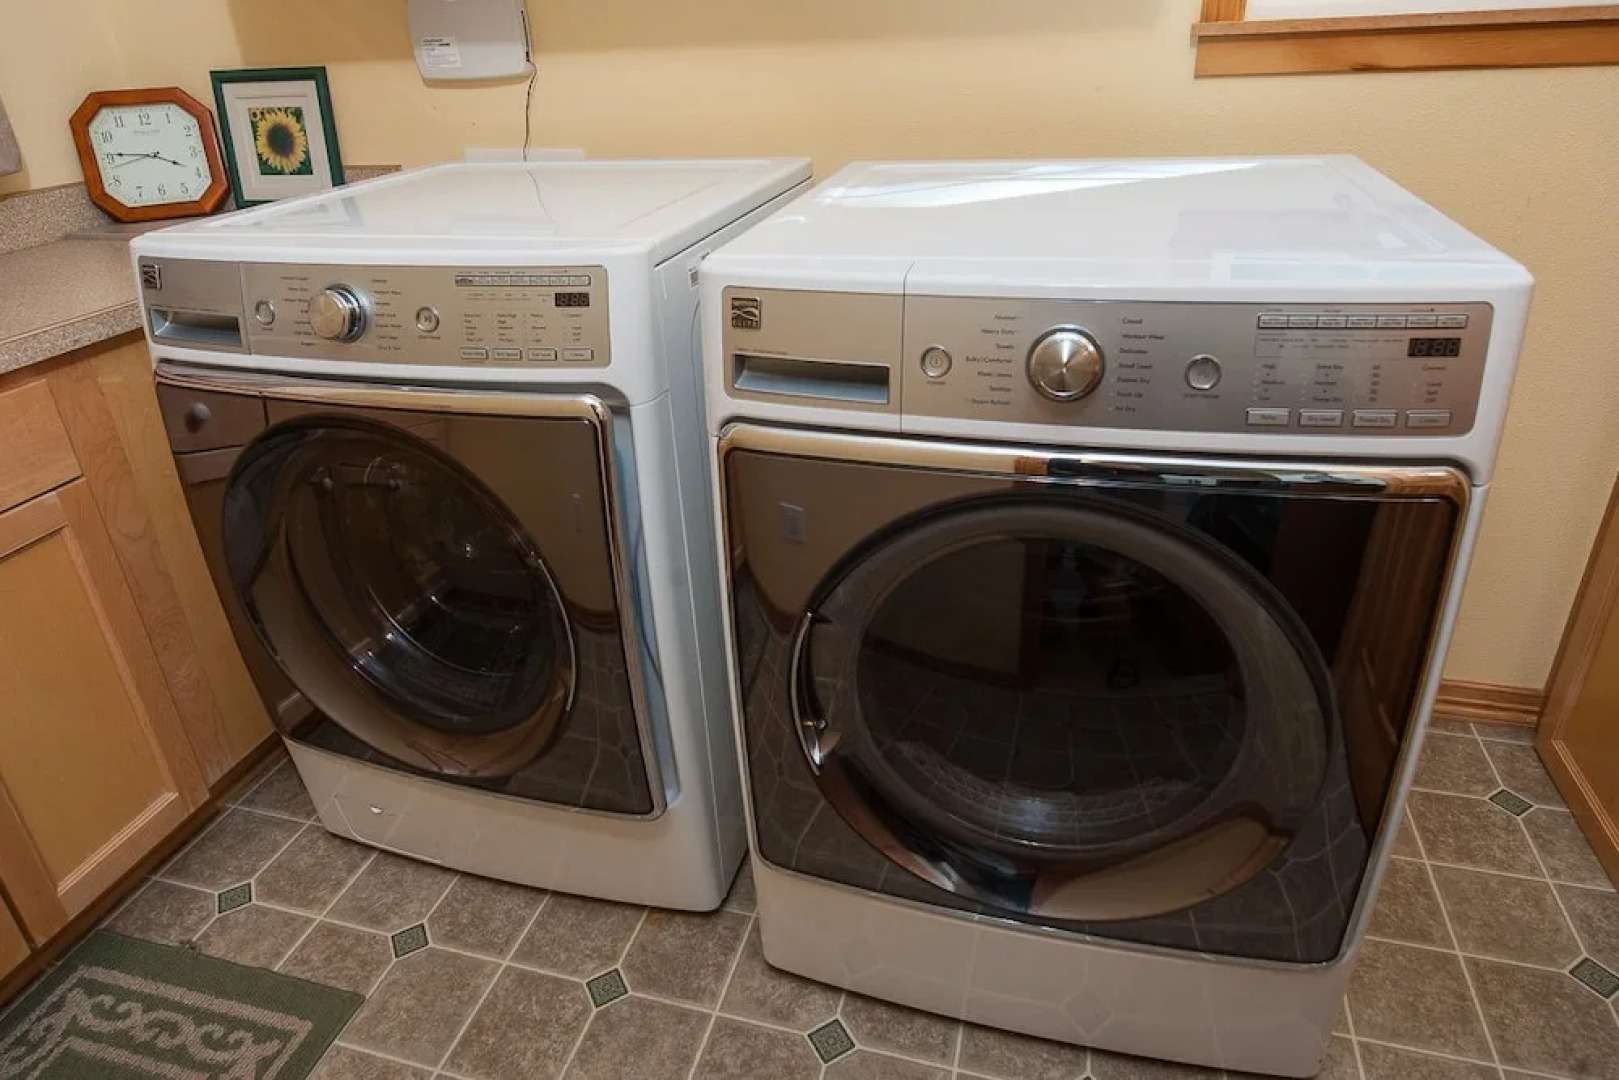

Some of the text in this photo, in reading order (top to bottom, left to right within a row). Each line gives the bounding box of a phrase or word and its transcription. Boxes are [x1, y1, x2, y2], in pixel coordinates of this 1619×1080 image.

[114, 116, 124, 128] 11
[138, 112, 151, 126] 12
[165, 112, 170, 124] 1
[183, 124, 192, 137] 2
[101, 131, 113, 143] 10
[189, 146, 198, 158] 3
[106, 152, 115, 165] 9
[113, 175, 122, 186] 8
[136, 185, 143, 197] 7
[157, 184, 166, 196] 6
[180, 182, 189, 194] 5
